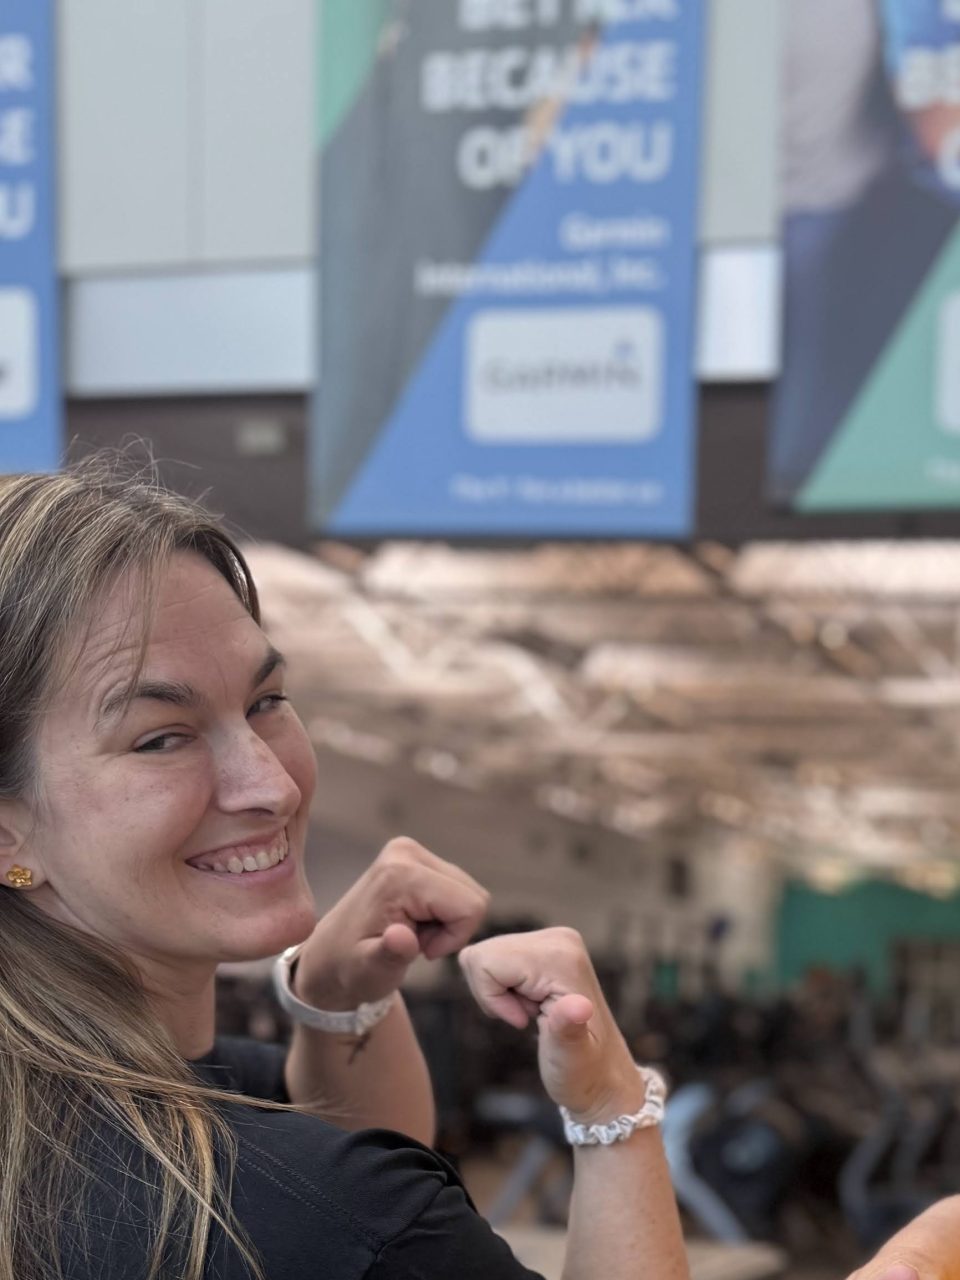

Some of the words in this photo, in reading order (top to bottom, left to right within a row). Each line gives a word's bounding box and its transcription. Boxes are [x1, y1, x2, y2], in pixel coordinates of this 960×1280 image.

[423, 43, 674, 110] BECAUSE
[458, 127, 541, 188] OF
[551, 122, 672, 181] YOU
